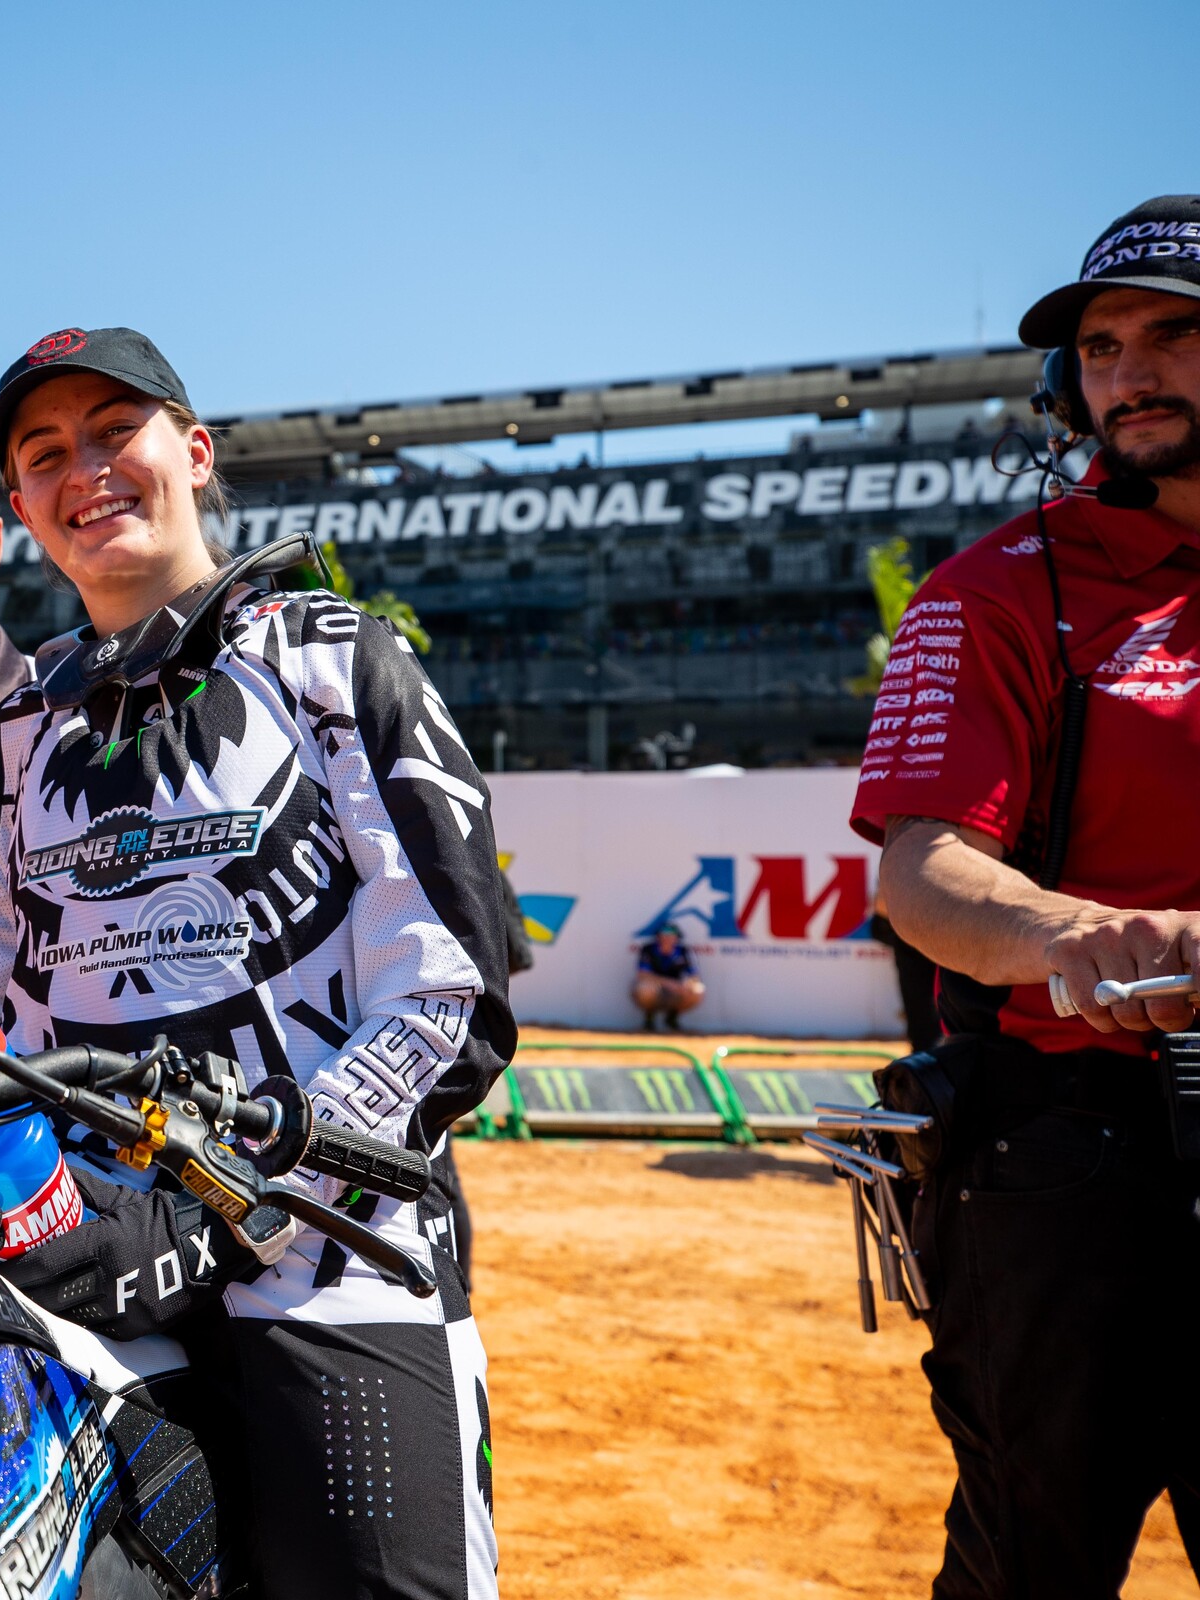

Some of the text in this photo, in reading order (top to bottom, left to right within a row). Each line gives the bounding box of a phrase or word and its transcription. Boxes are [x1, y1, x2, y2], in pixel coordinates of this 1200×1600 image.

[202, 479, 684, 549] NTERNATIONAL
[178, 668, 207, 682] JARVI
[1096, 659, 1200, 675] HONDA
[21, 815, 257, 880] RIDING ON THE EDGE
[190, 839, 247, 855] IOWA
[633, 854, 877, 940] AM
[40, 921, 249, 968] IOWA PUMP WORKS
[79, 946, 245, 975] Fluid Handling Professionals
[185, 1166, 243, 1218] PROTAPER
[116, 1225, 217, 1314] FOX
